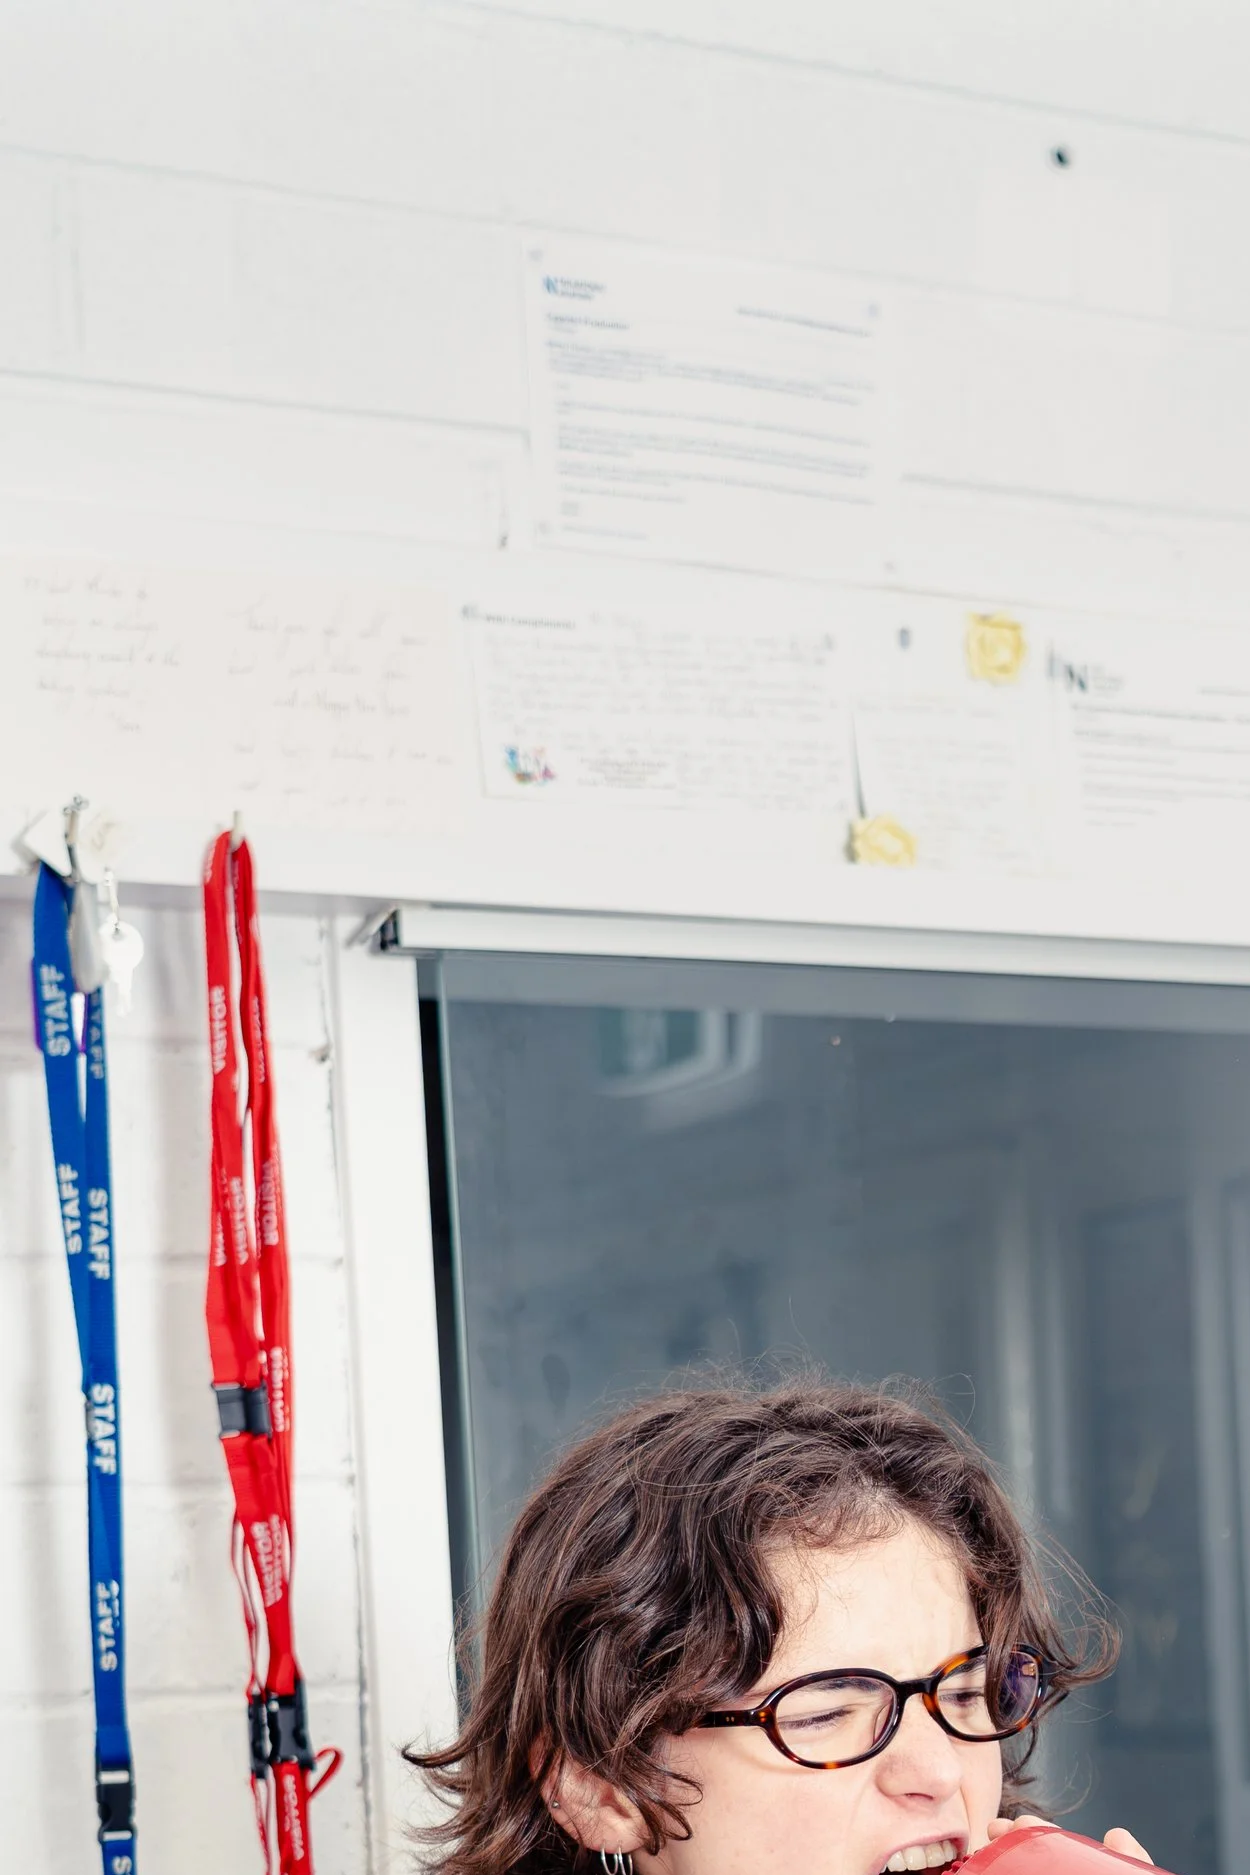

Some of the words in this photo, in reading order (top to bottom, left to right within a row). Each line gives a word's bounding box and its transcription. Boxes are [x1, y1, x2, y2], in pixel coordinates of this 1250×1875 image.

[41, 964, 71, 1057] STAFF
[209, 985, 227, 1076] VISITOR
[58, 1163, 82, 1255] STAFF
[87, 1188, 111, 1280] STAFF
[261, 1160, 279, 1245] VISITOR
[90, 1383, 117, 1475] STAFF
[96, 1581, 118, 1672] STAFF
[283, 1774, 304, 1862] VISITOR
